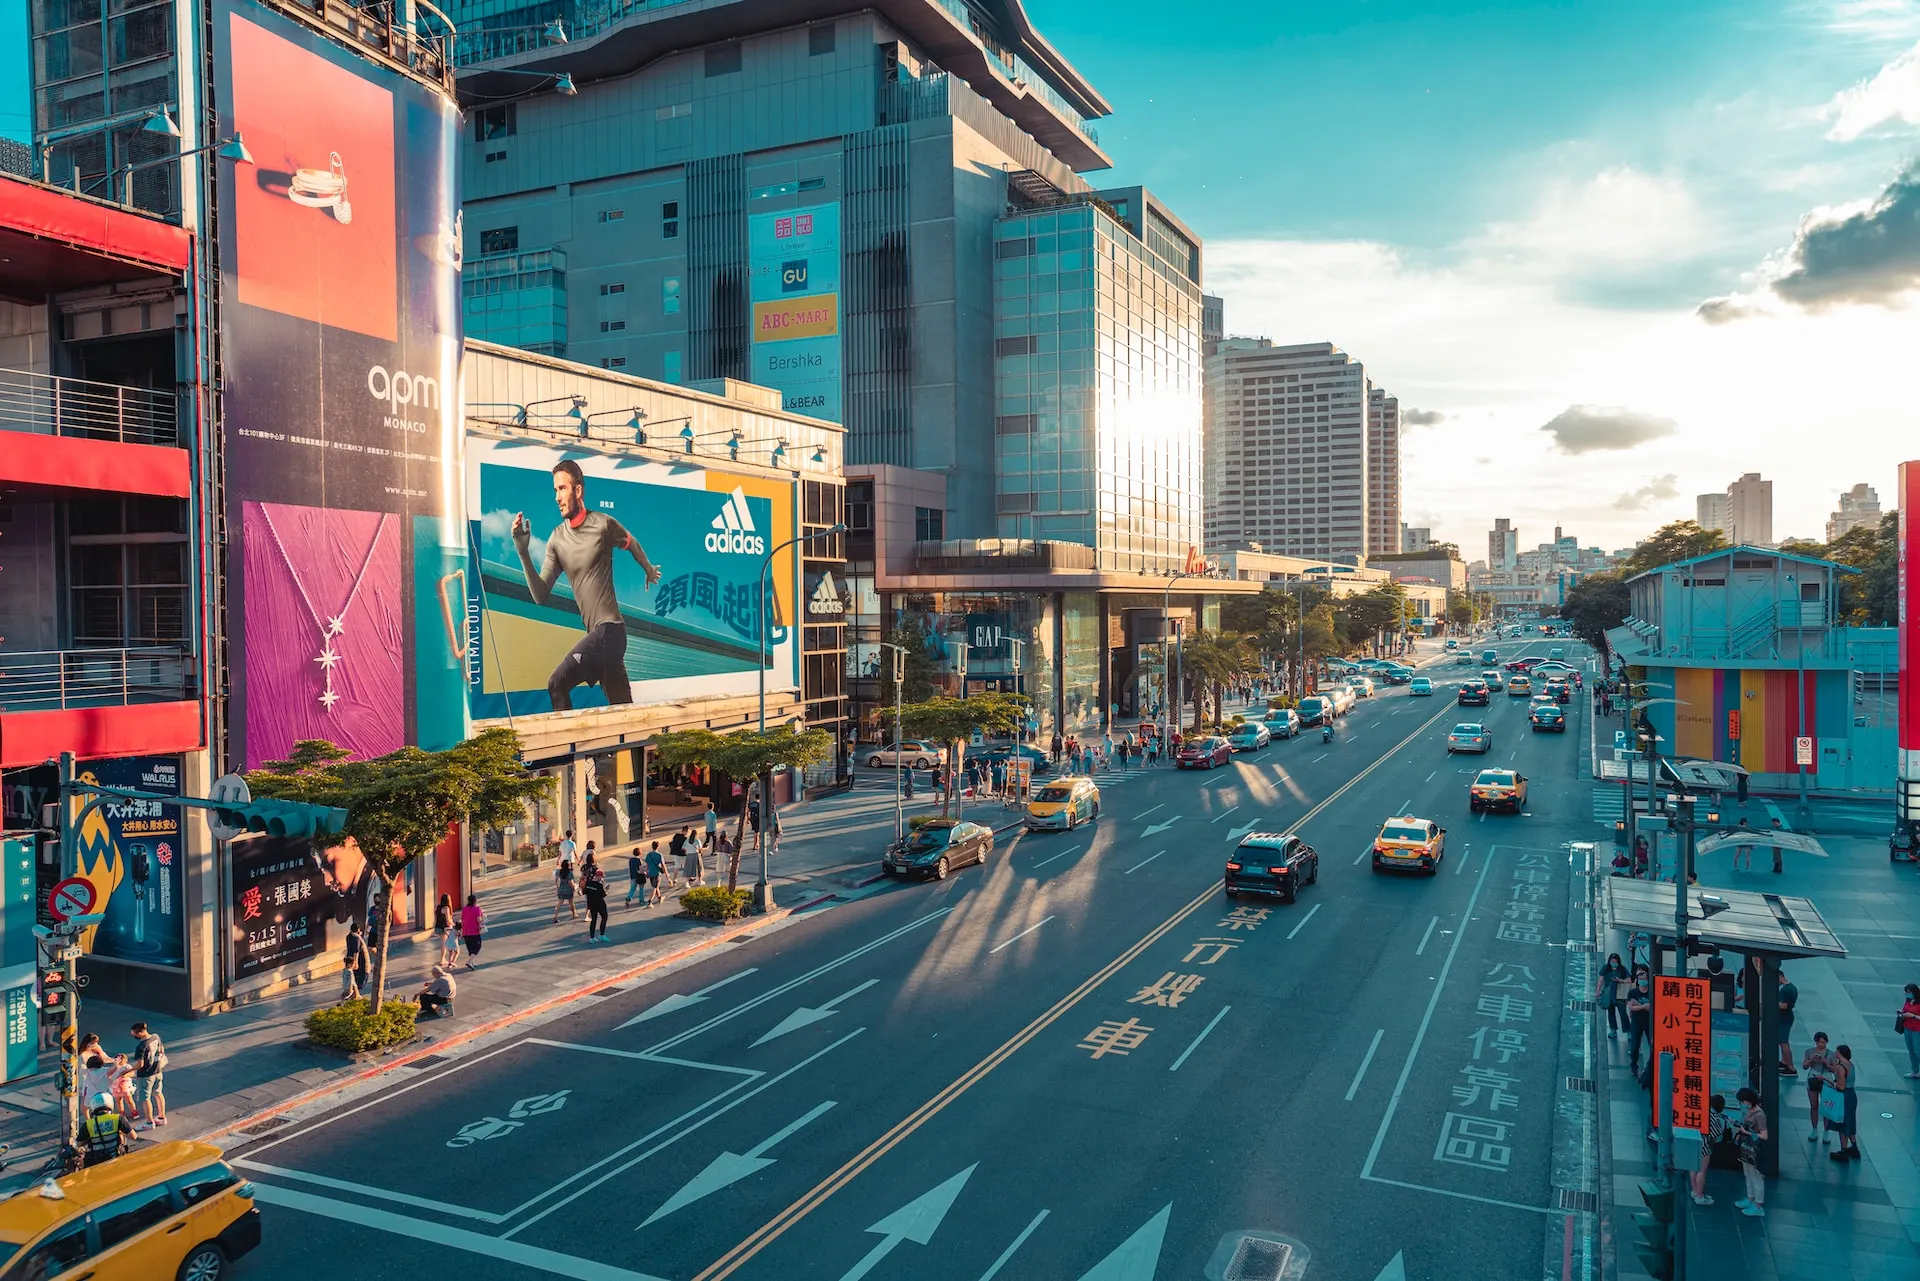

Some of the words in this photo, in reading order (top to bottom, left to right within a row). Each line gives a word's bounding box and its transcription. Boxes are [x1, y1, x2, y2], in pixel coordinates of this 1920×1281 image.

[783, 268, 806, 284] GU
[761, 309, 829, 330] ABC-MART
[769, 353, 822, 370] Bershka
[368, 365, 440, 415] apm
[782, 396, 825, 410] L&BEAR
[383, 416, 426, 433] MONACO
[704, 528, 765, 555] adidas
[654, 571, 788, 645] 領風起跑
[809, 600, 843, 614] adidas
[468, 595, 480, 685] CLIMACOOL
[975, 625, 1002, 647] GAP
[142, 773, 176, 783] WALRUS
[1496, 853, 1551, 945] 公車停靠區
[1076, 906, 1273, 1060] 禁行機車
[17, 988, 27, 1043] 2758-0055
[1433, 963, 1536, 1173] 公車停靠區
[1684, 982, 1703, 1128] 前方工程車輛進出
